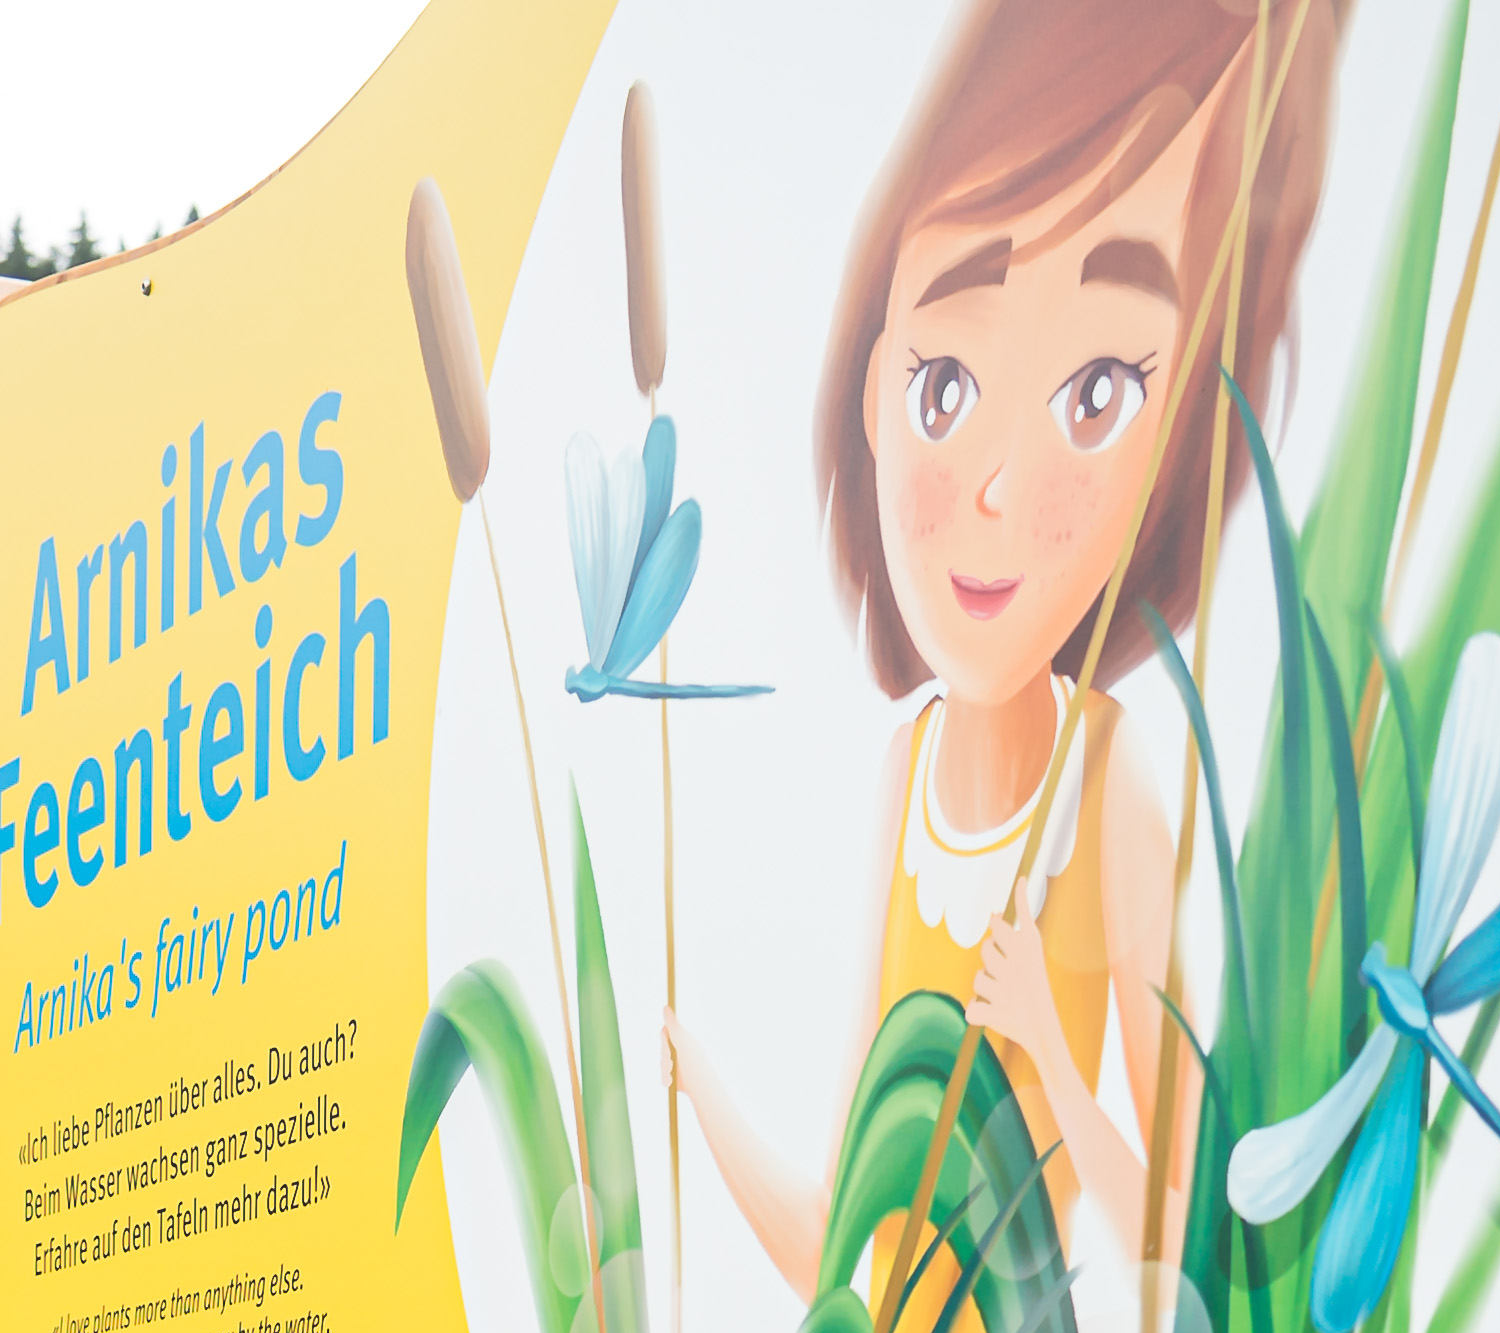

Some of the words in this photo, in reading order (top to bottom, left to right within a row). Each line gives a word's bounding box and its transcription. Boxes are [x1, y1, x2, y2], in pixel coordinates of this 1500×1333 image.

[20, 391, 345, 717] Arnikas
[13, 937, 143, 1055] Arnika's
[151, 905, 235, 1018] fairy
[242, 840, 347, 985] pond
[53, 1114, 89, 1156] liebe
[95, 1095, 163, 1142] Pflanzen
[169, 1076, 208, 1118] über
[213, 1059, 261, 1104] alles.
[268, 1047, 292, 1085] Du
[299, 1019, 357, 1075] auch?
[24, 1182, 60, 1222] Beim
[65, 1168, 122, 1210] Wasser
[126, 1145, 199, 1192] wachsen
[205, 1130, 248, 1178] ganz
[253, 1094, 346, 1162] spezielle.
[34, 1233, 88, 1276] Erfahre
[92, 1219, 118, 1261] auf
[122, 1215, 151, 1253] den
[156, 1199, 208, 1244] Tafeln
[214, 1184, 261, 1229] mehr
[134, 1298, 167, 1325] more
[170, 1288, 200, 1318] than
[203, 1272, 266, 1315] anything
[269, 1264, 303, 1296] else.
